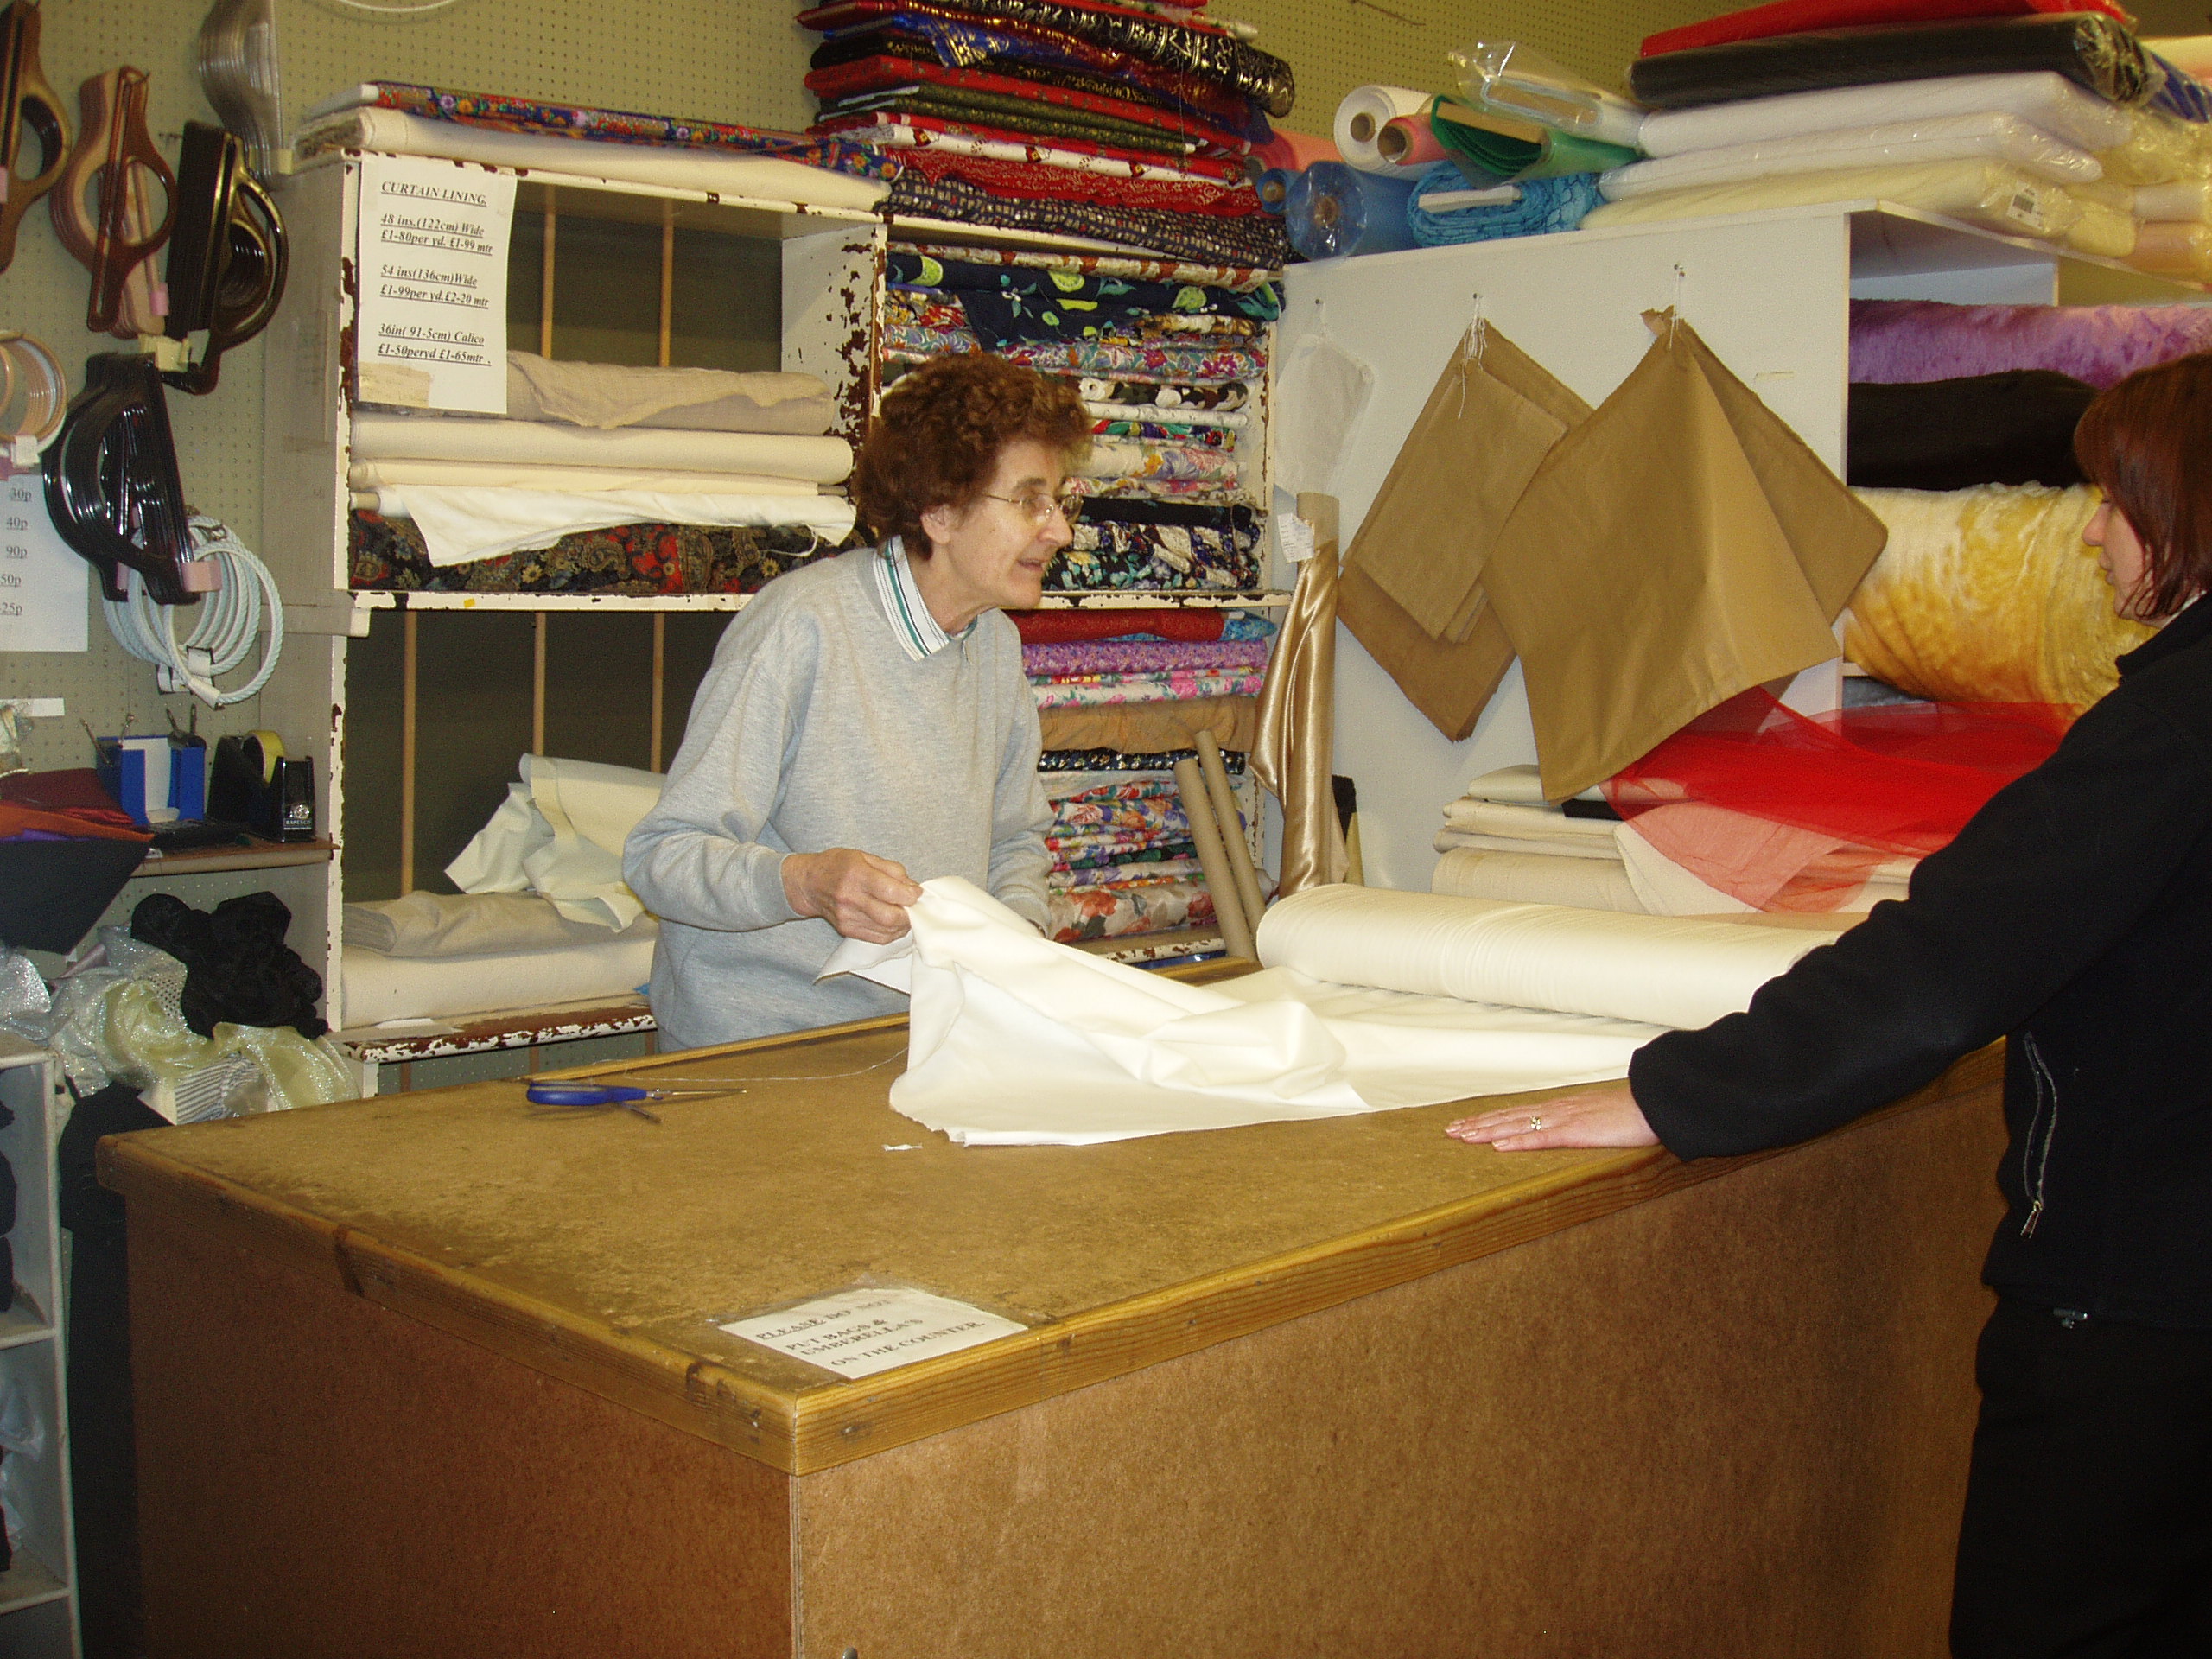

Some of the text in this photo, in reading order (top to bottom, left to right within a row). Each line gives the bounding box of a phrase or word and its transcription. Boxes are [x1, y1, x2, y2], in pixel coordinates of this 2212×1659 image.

[381, 181, 486, 205] CURTAIN LINING.
[380, 213, 394, 224] 48
[461, 222, 485, 236] Wide
[381, 229, 429, 245] £1-80per
[450, 237, 475, 250] £1-99
[477, 244, 493, 253] mtr
[380, 264, 394, 276] 54
[380, 284, 428, 300] £1-99per
[474, 297, 489, 307] mtr
[454, 331, 484, 344] Calico
[10, 487, 32, 501] 30p
[7, 517, 29, 531] 40p
[6, 546, 28, 559] 90p
[0, 602, 22, 615] 25p
[756, 1319, 826, 1338] PLEASE
[785, 1338, 820, 1350] PUT
[823, 1325, 871, 1340] BAGS
[831, 1356, 858, 1366] ON
[860, 1344, 899, 1357] THE
